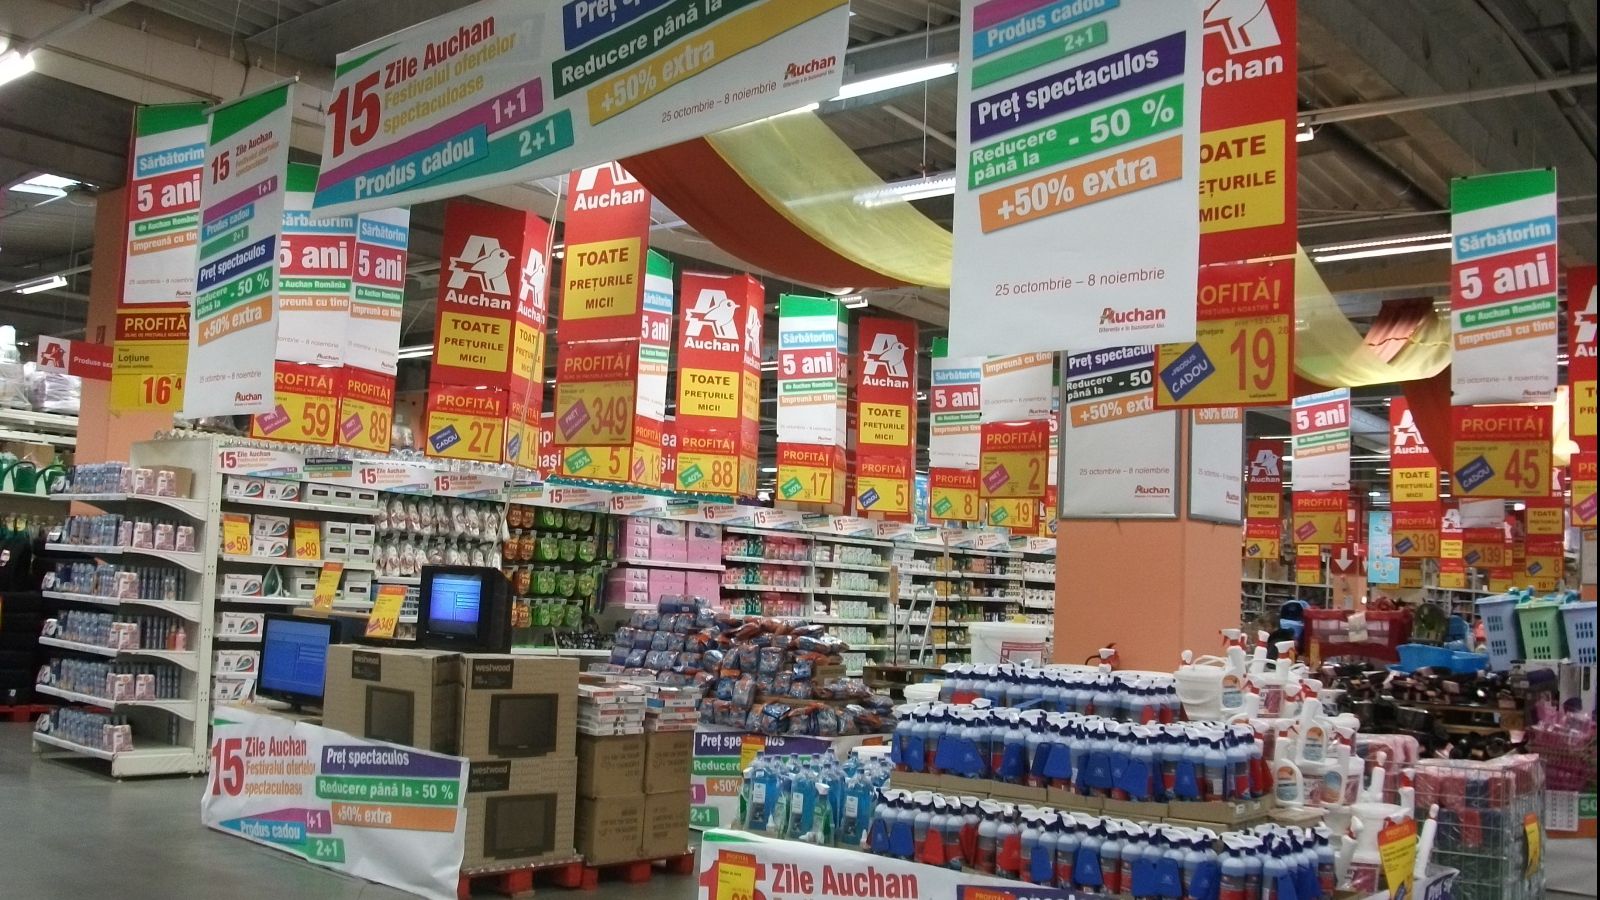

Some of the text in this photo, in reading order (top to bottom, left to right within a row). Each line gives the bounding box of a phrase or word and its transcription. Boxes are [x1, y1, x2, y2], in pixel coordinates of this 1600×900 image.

[988, 14, 1046, 48] Produs
[1064, 28, 1093, 51] 2+1
[384, 16, 495, 90] Zile Auchan
[562, 3, 699, 86] Reducere până
[384, 32, 517, 109] Festivalul ofertelor
[601, 40, 715, 112] +50% extra
[784, 55, 836, 80] Auchan
[1201, 55, 1284, 88] chan
[978, 50, 1159, 125] Preț spectaculos
[384, 74, 485, 135] spectaculoase
[492, 88, 527, 124] 1+1
[662, 80, 777, 123] 25 octombrie noiembrie
[328, 70, 381, 158] 15
[249, 130, 272, 150] Auchan
[518, 120, 555, 158] 2+1
[972, 94, 1175, 166] Reducere 50 %
[140, 147, 204, 171] Sărbătorim
[1200, 134, 1266, 164] OATE
[212, 151, 230, 185] 15
[355, 136, 474, 200] Produs cadou
[974, 152, 1040, 186] până la
[138, 174, 200, 212] 5 ani
[258, 181, 272, 196] 1+1
[998, 155, 1158, 221] +50% extra
[574, 188, 644, 212] Auchan
[206, 208, 250, 235] Produs cadou
[1199, 203, 1246, 223] MICI!
[174, 235, 184, 243] cu
[234, 229, 244, 242] 2+1
[1460, 223, 1551, 253] Sărbătorim
[218, 244, 266, 274] spectaculos
[302, 241, 348, 269] ani
[359, 250, 402, 281] 5 ani
[578, 248, 629, 267] TOATE
[570, 274, 633, 291] PREȚURILE
[995, 268, 1165, 296] 25 octombrie 8 noiembrie
[1460, 252, 1550, 300] 5 ani
[445, 290, 511, 310] Auchan
[586, 297, 614, 310] MICI!
[1200, 276, 1281, 310] OFITĂ!
[1100, 308, 1166, 325] Auchan
[1478, 301, 1551, 321] Auchan România
[204, 306, 263, 340] +50% extra
[452, 319, 500, 335] TOATE
[652, 318, 669, 342] ani
[1516, 320, 1555, 334] cu tine
[444, 337, 504, 352] PREȚURILE
[684, 337, 739, 352] Auchan
[783, 332, 835, 344] Sărbătorim
[74, 356, 101, 367] Produse
[118, 354, 150, 365] Loțiune
[460, 354, 487, 364] MICI!
[783, 352, 833, 375] 5 ani
[1069, 356, 1092, 371] Preț
[1230, 328, 1275, 391] 19
[690, 374, 731, 386] TOATE
[863, 376, 909, 389] Auchan
[1067, 376, 1113, 391] Reducere
[1172, 360, 1208, 393] CADOU
[143, 376, 172, 405] 16
[234, 392, 263, 402] Auchan
[684, 390, 735, 400] PREȚURILE
[935, 388, 979, 408] 5 ani
[1067, 386, 1104, 401] până la
[437, 394, 500, 416] PROFITĂ!
[868, 408, 902, 418] TOATE
[1080, 402, 1123, 422] +50%
[302, 402, 330, 437] 59
[591, 396, 628, 436] 349
[864, 422, 905, 430] PREȚURILE
[1296, 404, 1345, 430] 5 ani
[1462, 416, 1544, 437] PROFITĂ!
[369, 410, 388, 445] 89
[468, 422, 496, 453] 27
[219, 452, 237, 469] 15
[609, 448, 621, 475] 5
[862, 464, 905, 478] PROFITĂ!
[1504, 448, 1540, 489] 45
[360, 469, 377, 484] 15
[434, 476, 450, 491] 15
[712, 460, 733, 488] 88
[810, 472, 828, 497] 17
[1028, 458, 1040, 490] 2
[1400, 471, 1430, 479] TOATE
[550, 490, 562, 503] 15
[896, 484, 904, 506] 5
[1135, 485, 1170, 494] Auchan
[611, 496, 624, 510] 15
[703, 506, 715, 519] 15
[964, 494, 972, 516] 8
[1016, 502, 1030, 522] 19
[755, 512, 766, 524] 15
[833, 520, 844, 531] 15
[1334, 516, 1342, 538] 4
[236, 536, 248, 551] 59
[306, 542, 317, 556] 89
[1413, 534, 1436, 552] 319
[476, 664, 511, 673] westwood
[245, 736, 307, 758] Zile Auchan
[701, 734, 721, 751] Preț
[212, 738, 245, 797] 15
[246, 760, 285, 775] Festivalul
[327, 748, 409, 770] Preț spectaculos
[320, 780, 453, 800] Reducere la 50 %
[713, 780, 741, 792] +50%
[338, 806, 392, 823] +50% extra
[691, 808, 710, 822] 2+1
[241, 820, 300, 840] Produs cadou
[316, 840, 338, 856] 2+1
[772, 863, 814, 894] Zile
[822, 864, 918, 899] Auchan
